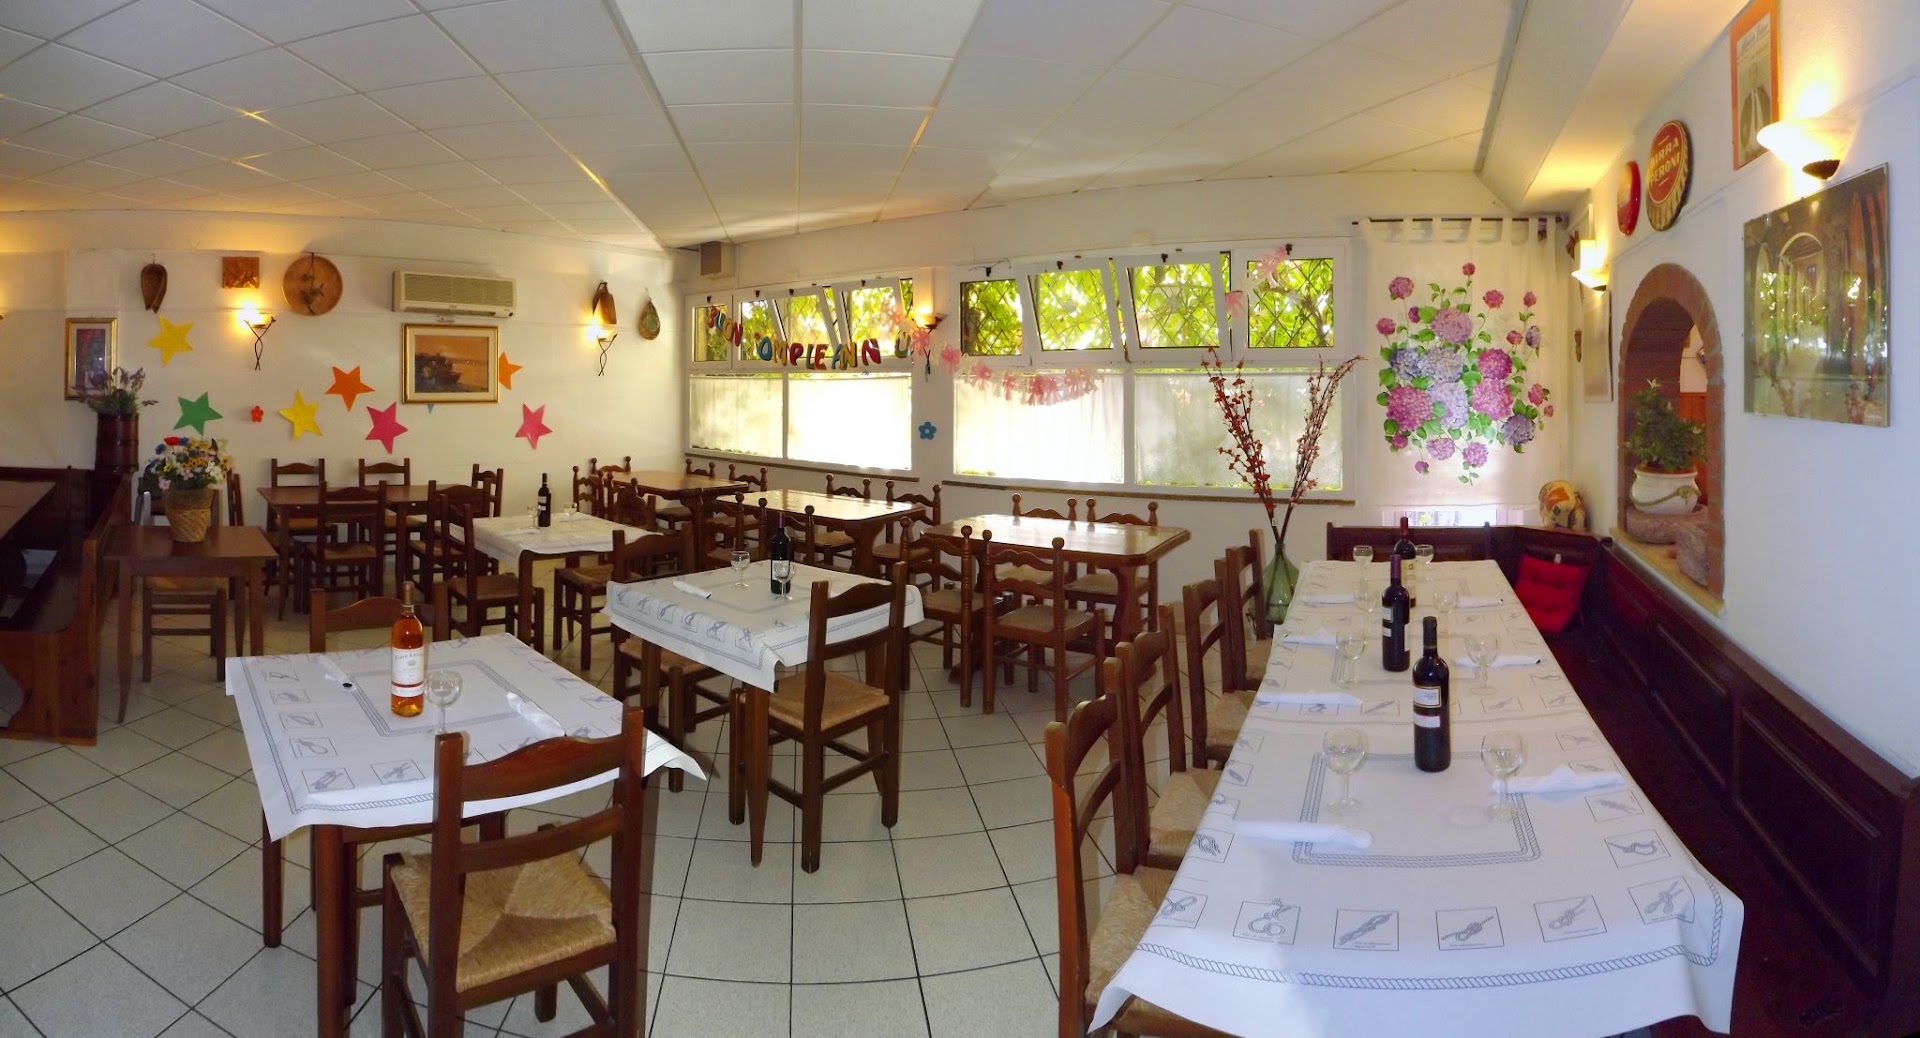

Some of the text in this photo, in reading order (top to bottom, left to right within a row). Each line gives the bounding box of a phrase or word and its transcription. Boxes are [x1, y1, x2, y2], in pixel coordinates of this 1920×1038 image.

[1650, 136, 1680, 167] BIRRA
[1650, 151, 1681, 187] PERONI
[707, 304, 912, 371] BUON OMPLEANNO
